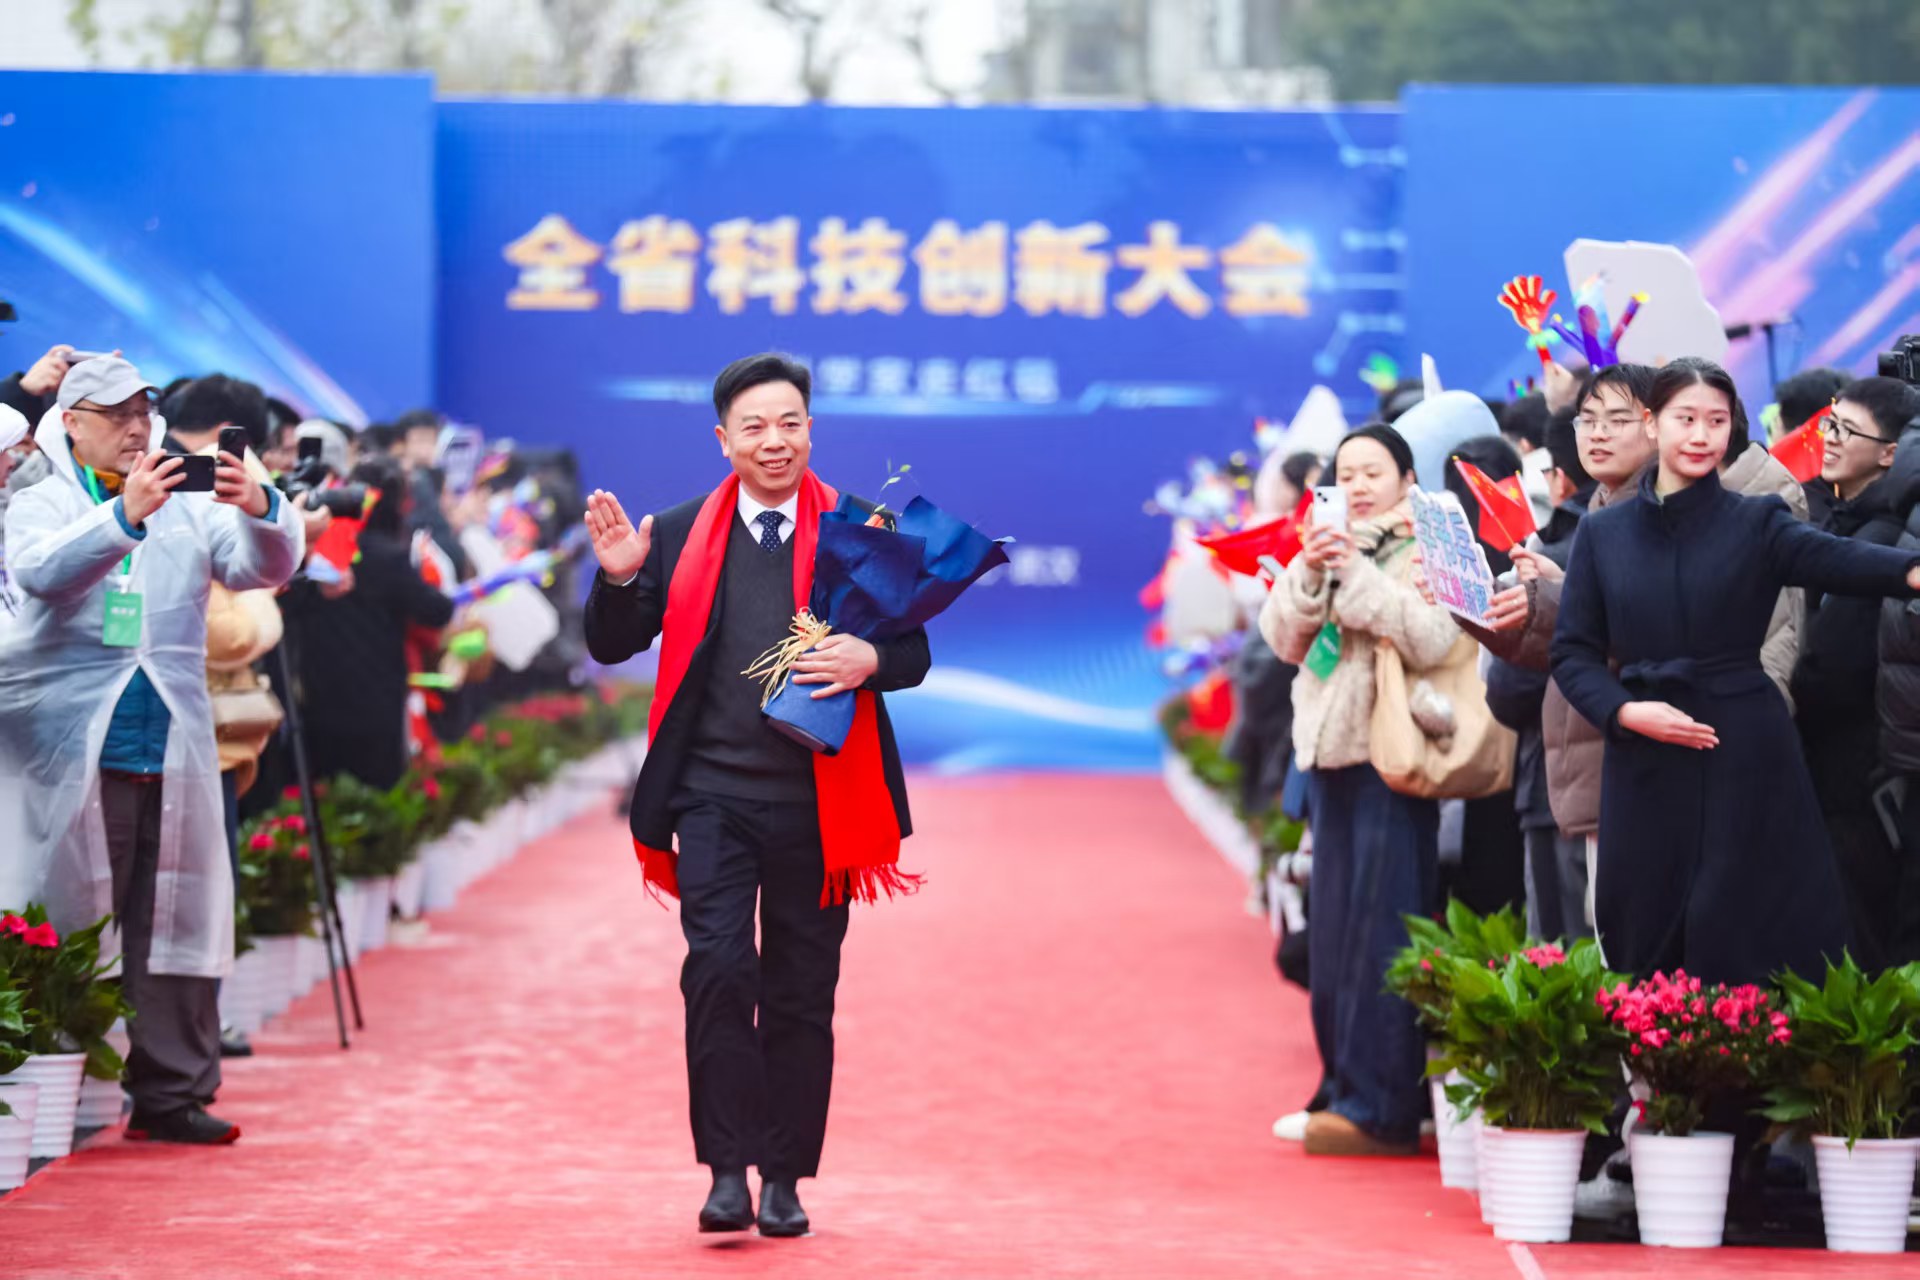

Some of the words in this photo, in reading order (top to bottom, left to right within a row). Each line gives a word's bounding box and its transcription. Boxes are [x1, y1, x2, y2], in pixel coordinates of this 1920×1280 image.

[504, 214, 1312, 318] 全省科技创新大会
